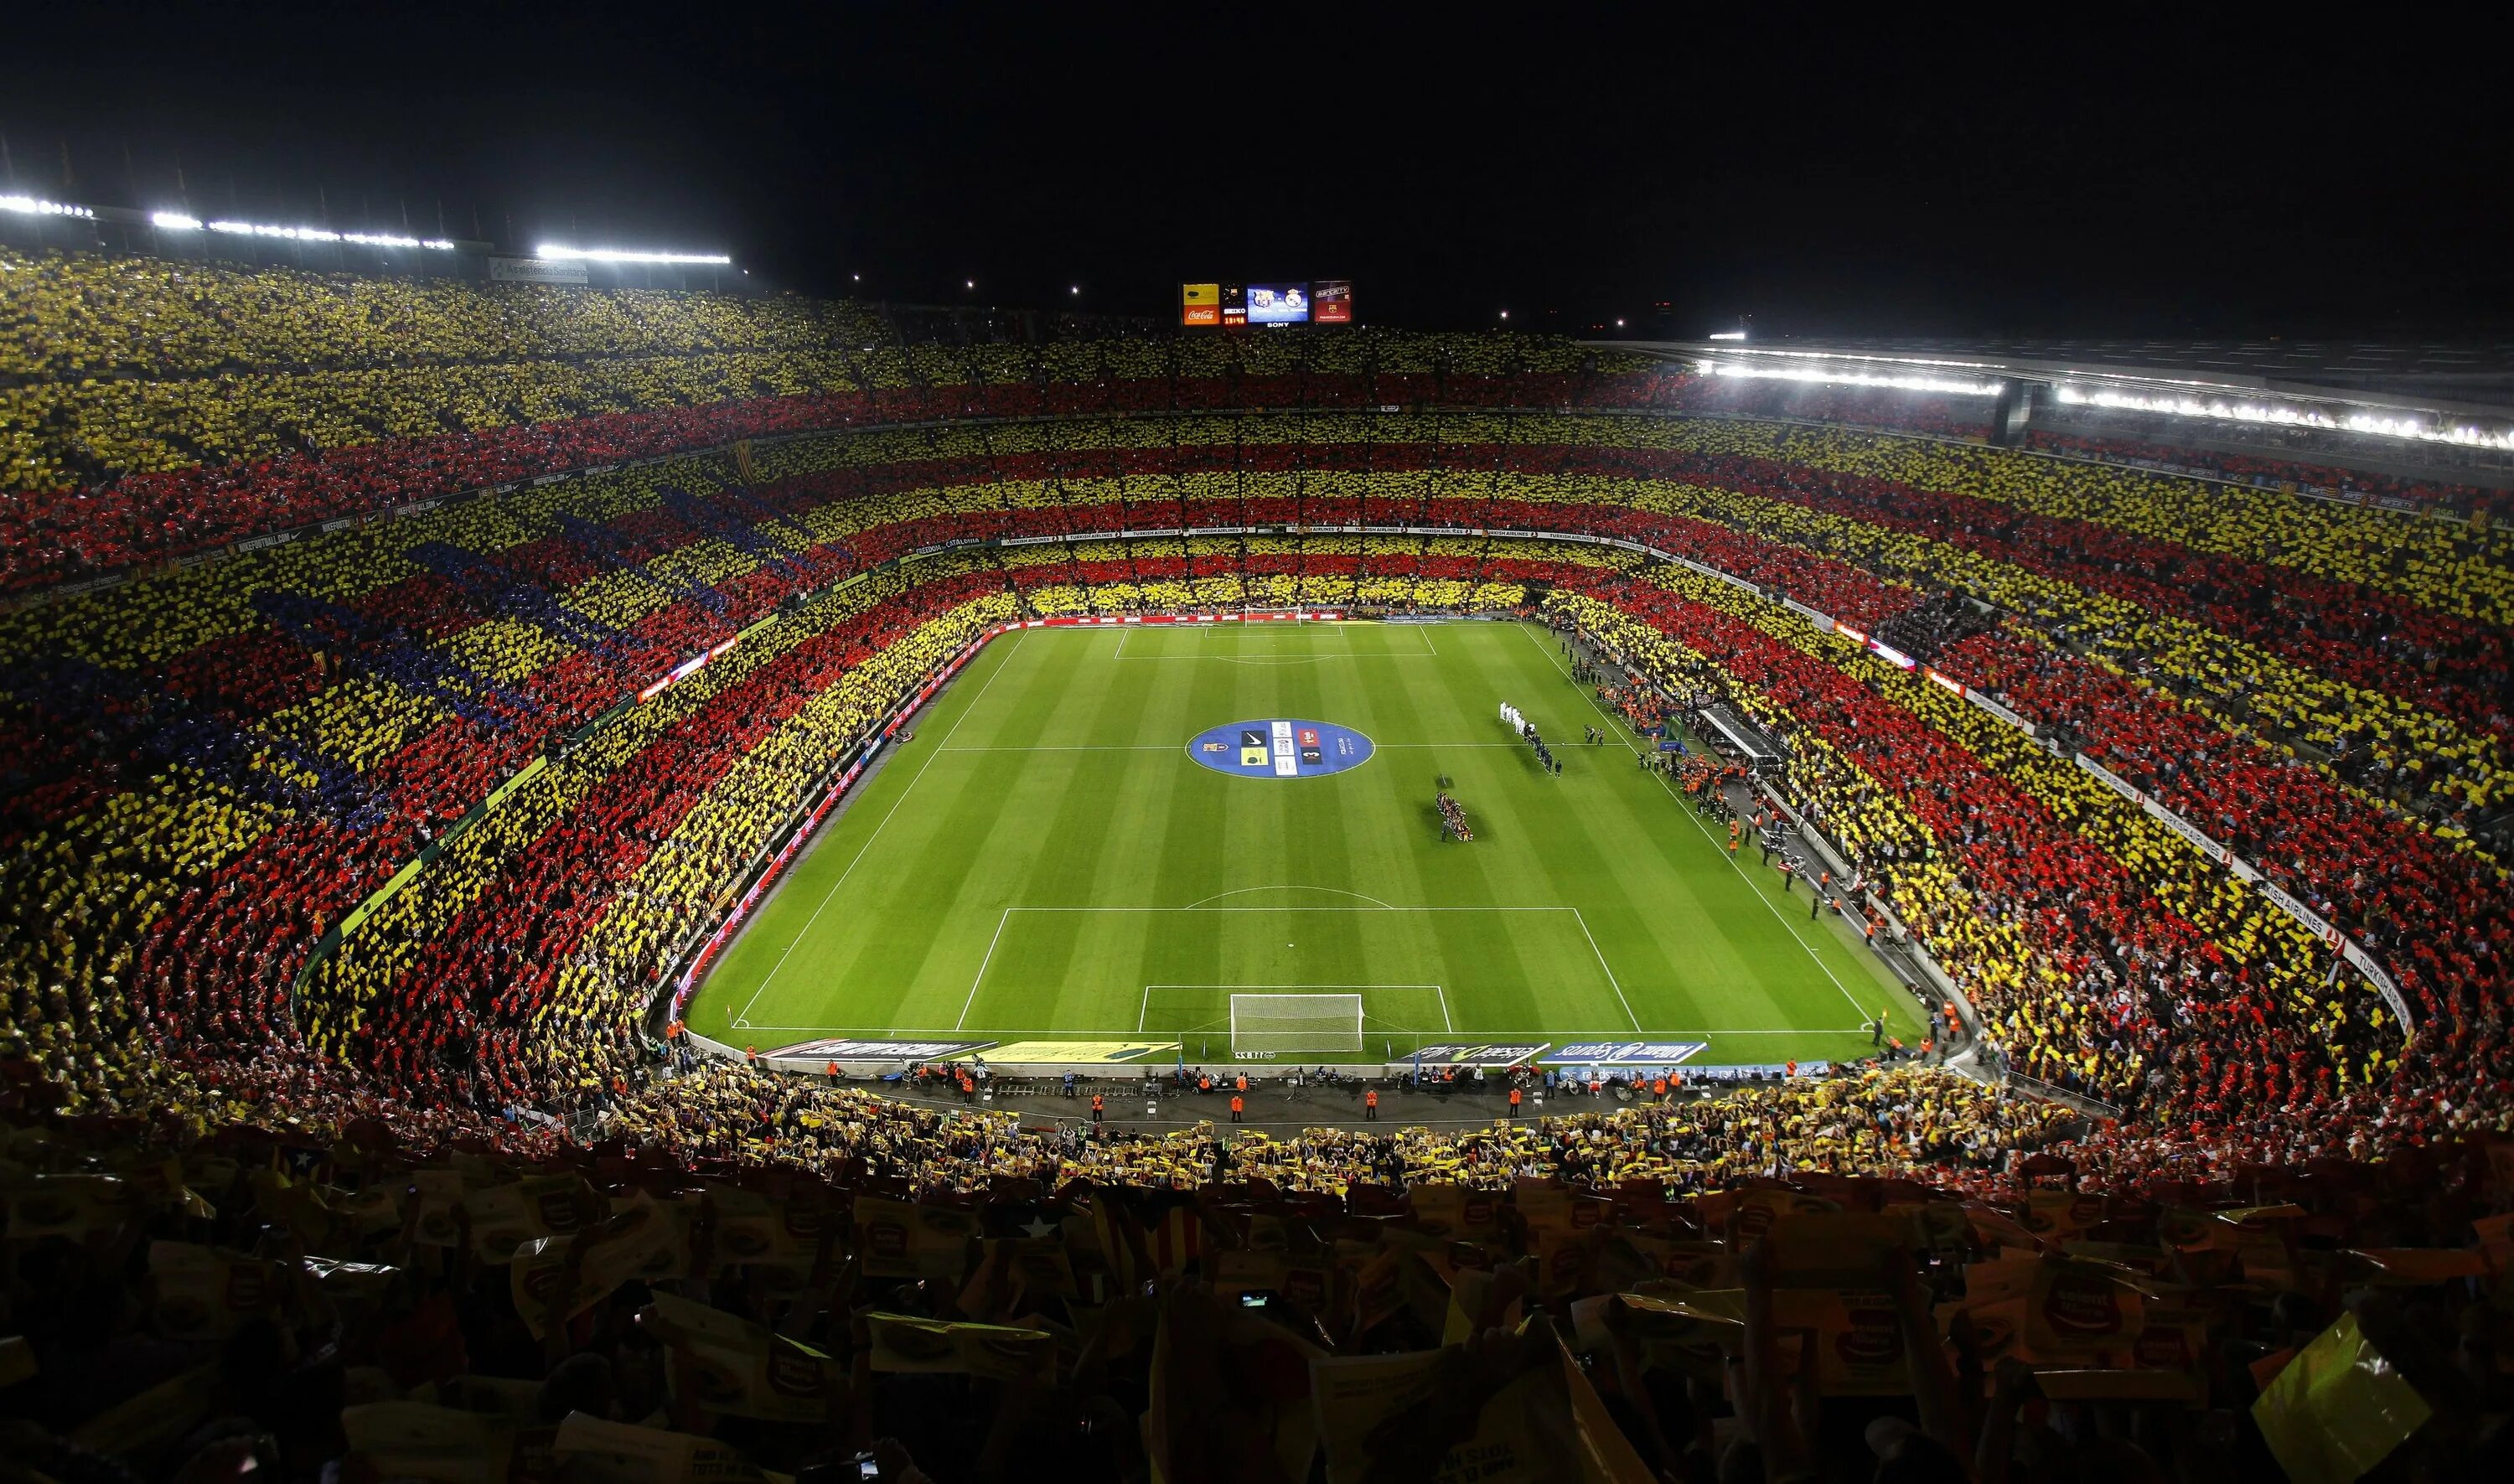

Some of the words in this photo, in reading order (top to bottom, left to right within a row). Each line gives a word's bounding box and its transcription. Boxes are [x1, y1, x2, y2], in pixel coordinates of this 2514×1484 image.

[239, 533, 290, 553] NIKEFOOTBALL.COM
[916, 545, 942, 555] FREEDOM
[2082, 758, 2107, 778] TURKISH
[2107, 775, 2134, 798] AIRLINES
[2160, 809, 2188, 835] TURKISH
[2188, 830, 2220, 857] AIRLINES
[2250, 873, 2284, 907] TUKISH
[2284, 894, 2323, 933] AIRLINES
[2359, 955, 2389, 997] TURKISH
[1635, 1045, 1691, 1057] Allianz
